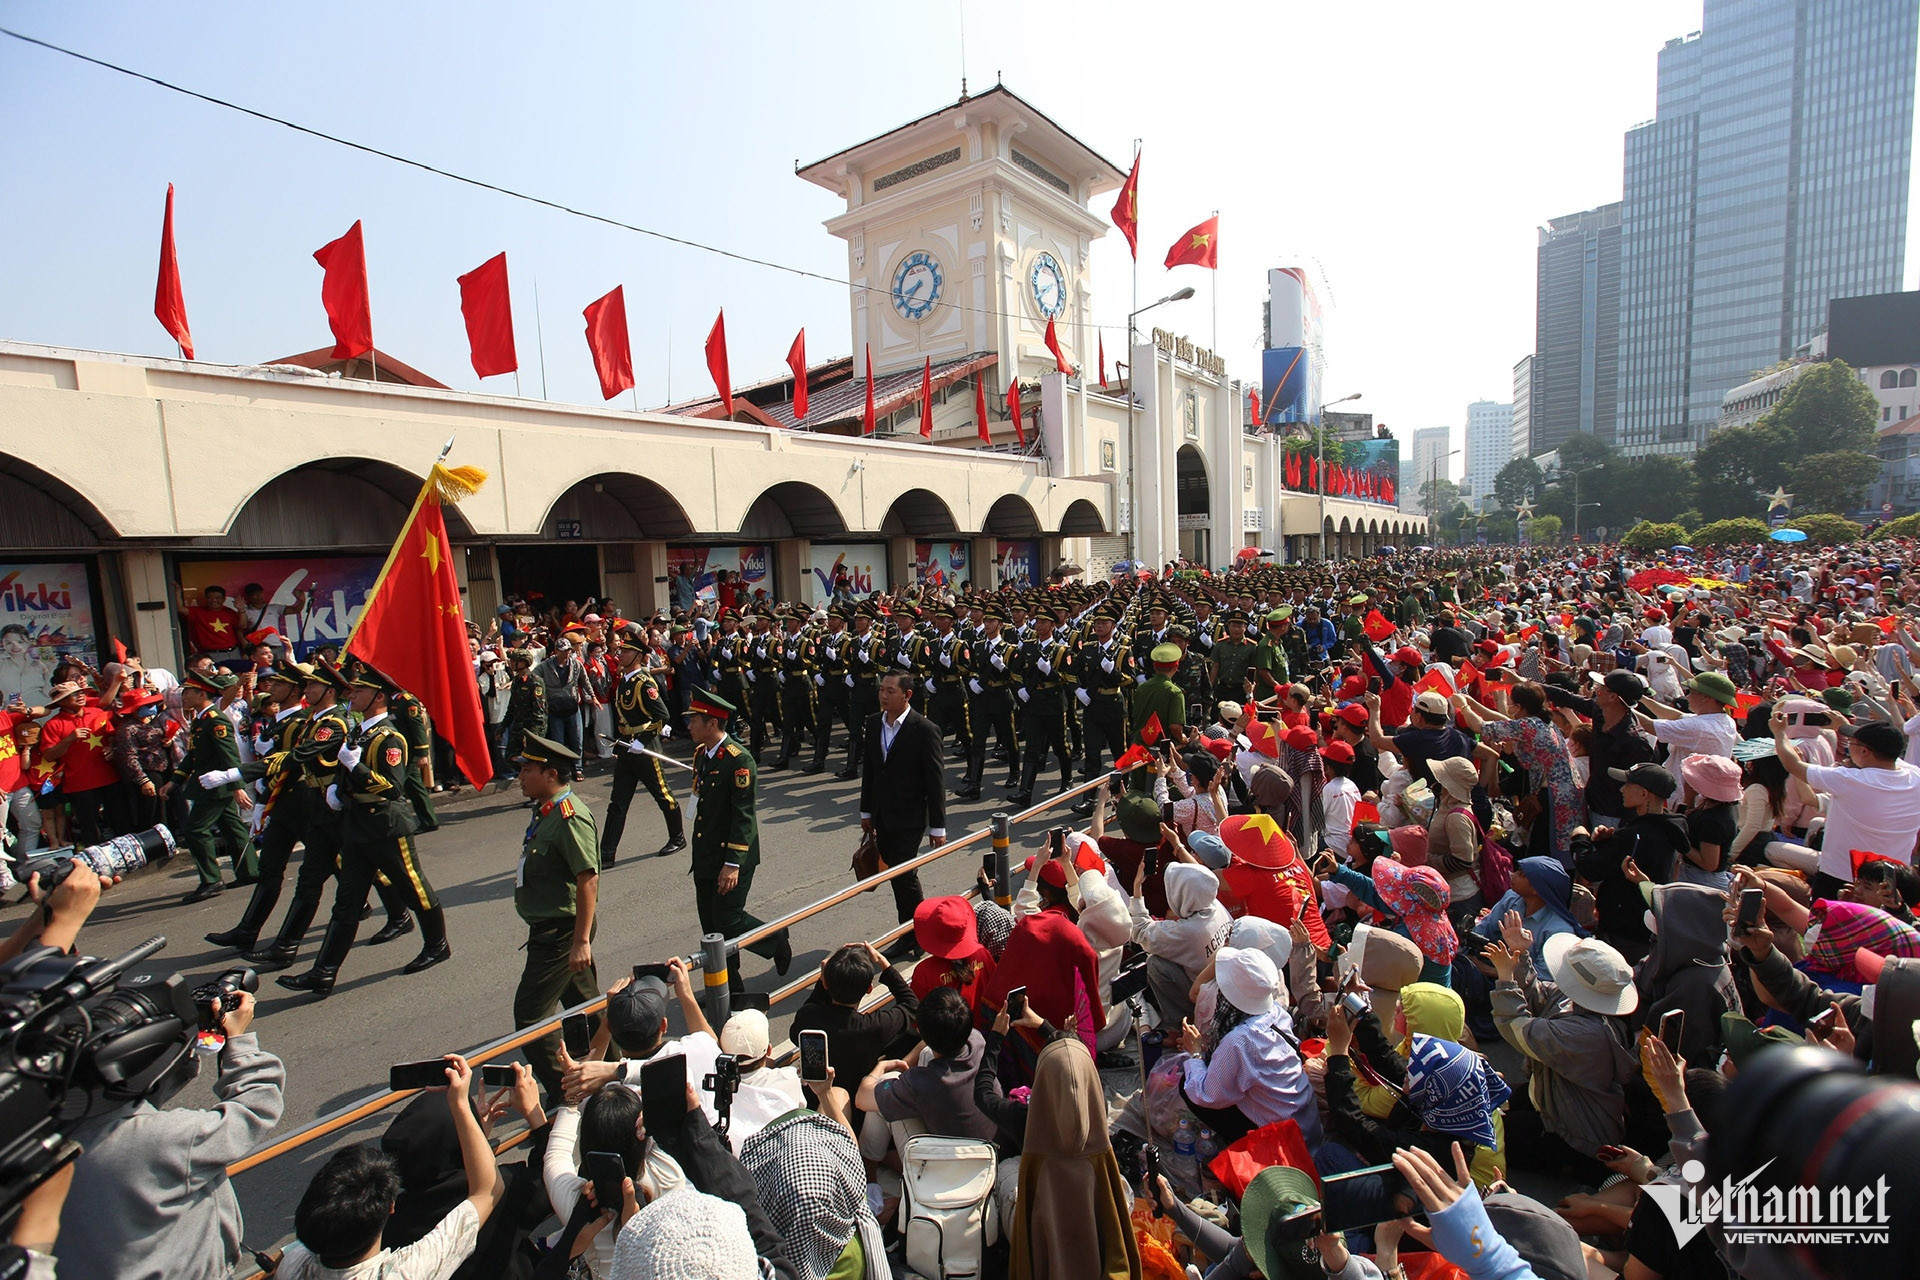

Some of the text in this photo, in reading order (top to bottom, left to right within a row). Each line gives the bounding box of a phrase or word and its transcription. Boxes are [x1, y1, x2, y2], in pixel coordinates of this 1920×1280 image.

[572, 522, 581, 537] 2
[740, 552, 765, 571] Vikki
[1440, 1114, 1474, 1124] LIMITED
